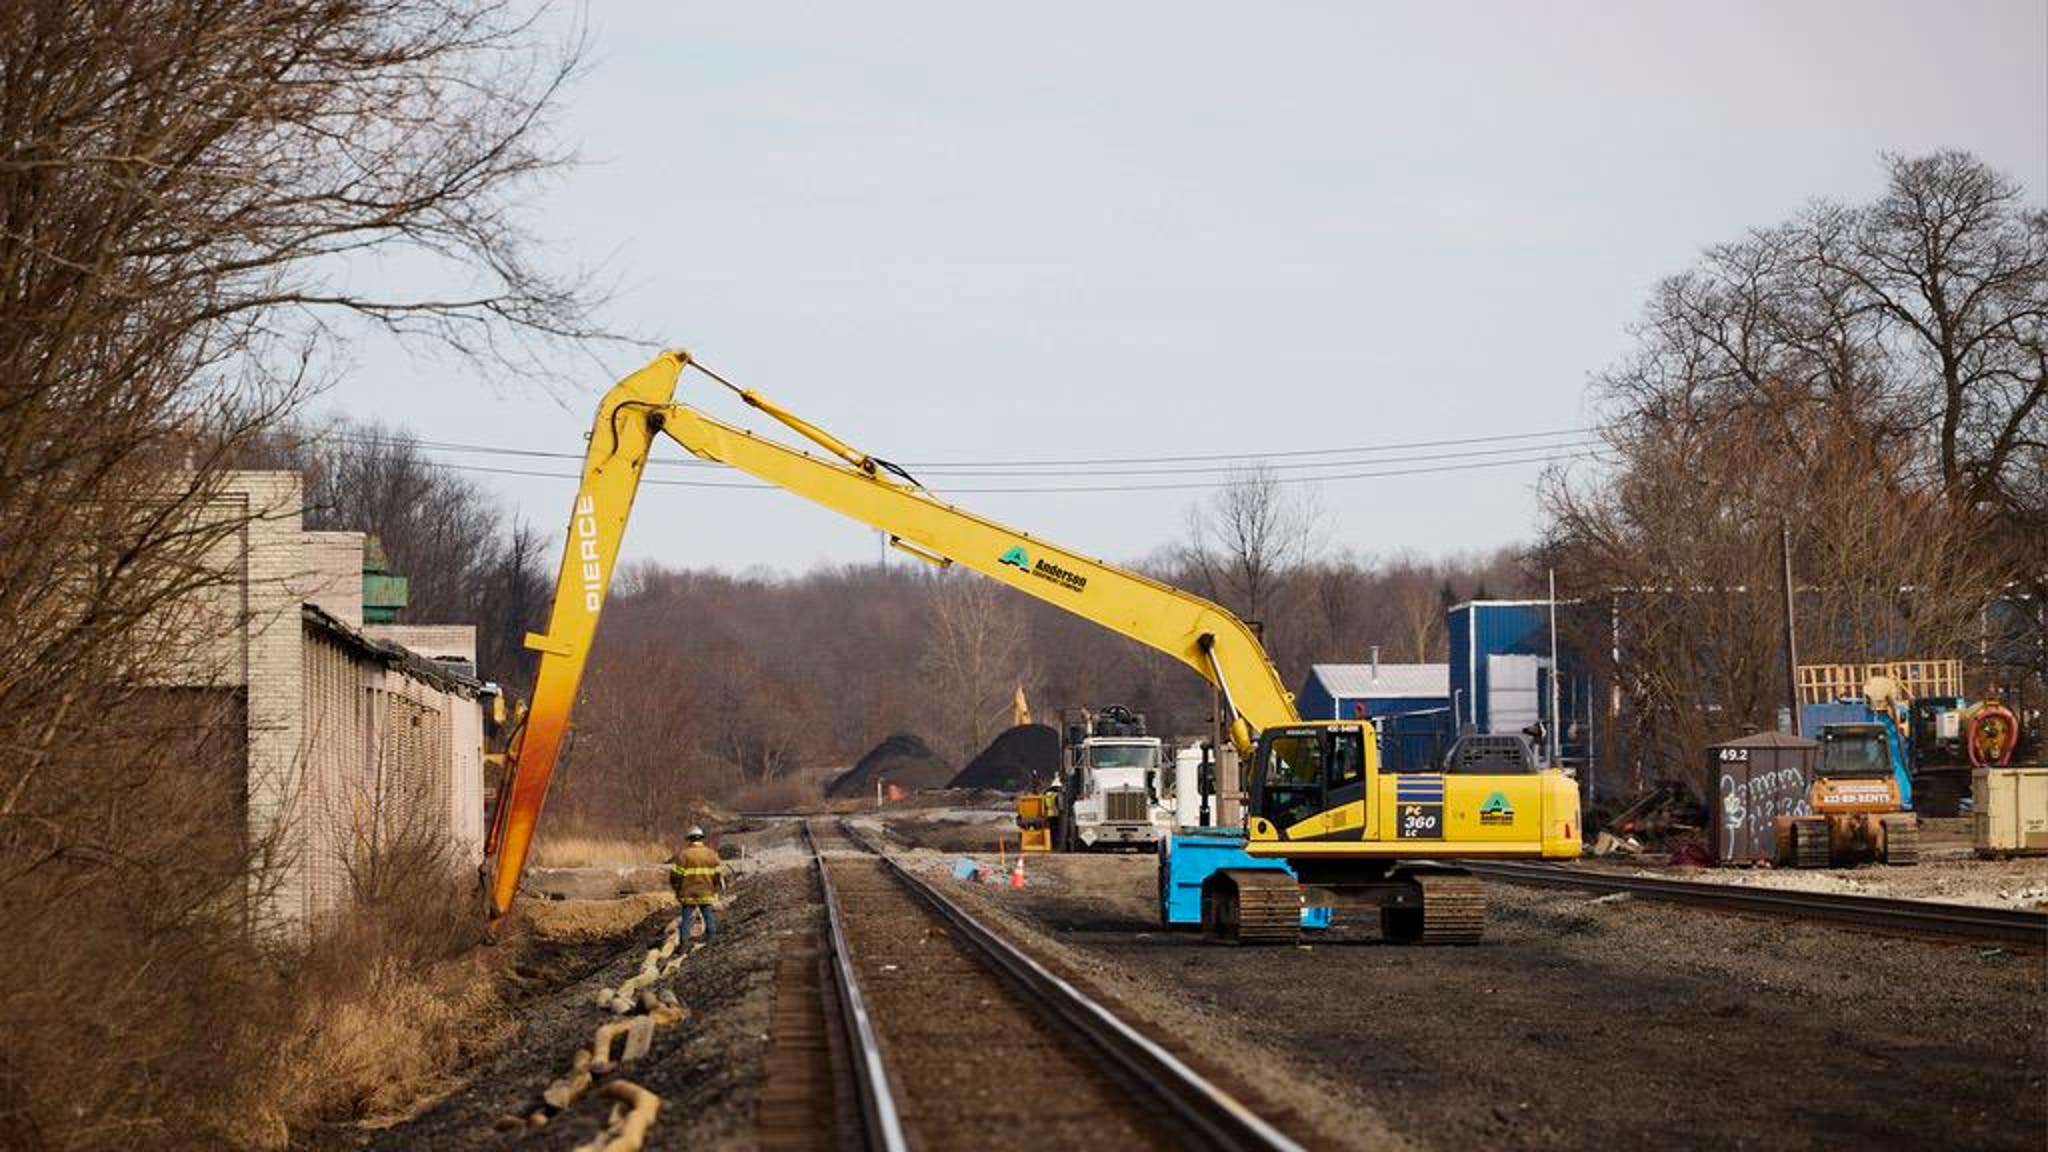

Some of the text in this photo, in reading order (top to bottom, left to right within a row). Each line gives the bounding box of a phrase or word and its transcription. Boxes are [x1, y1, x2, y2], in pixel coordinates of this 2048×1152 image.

[578, 495, 601, 613] PIERCE
[1034, 558, 1087, 588] Anderson
[1720, 749, 1747, 761] 49.2
[1405, 805, 1421, 816] PC
[1404, 815, 1436, 829] 360
